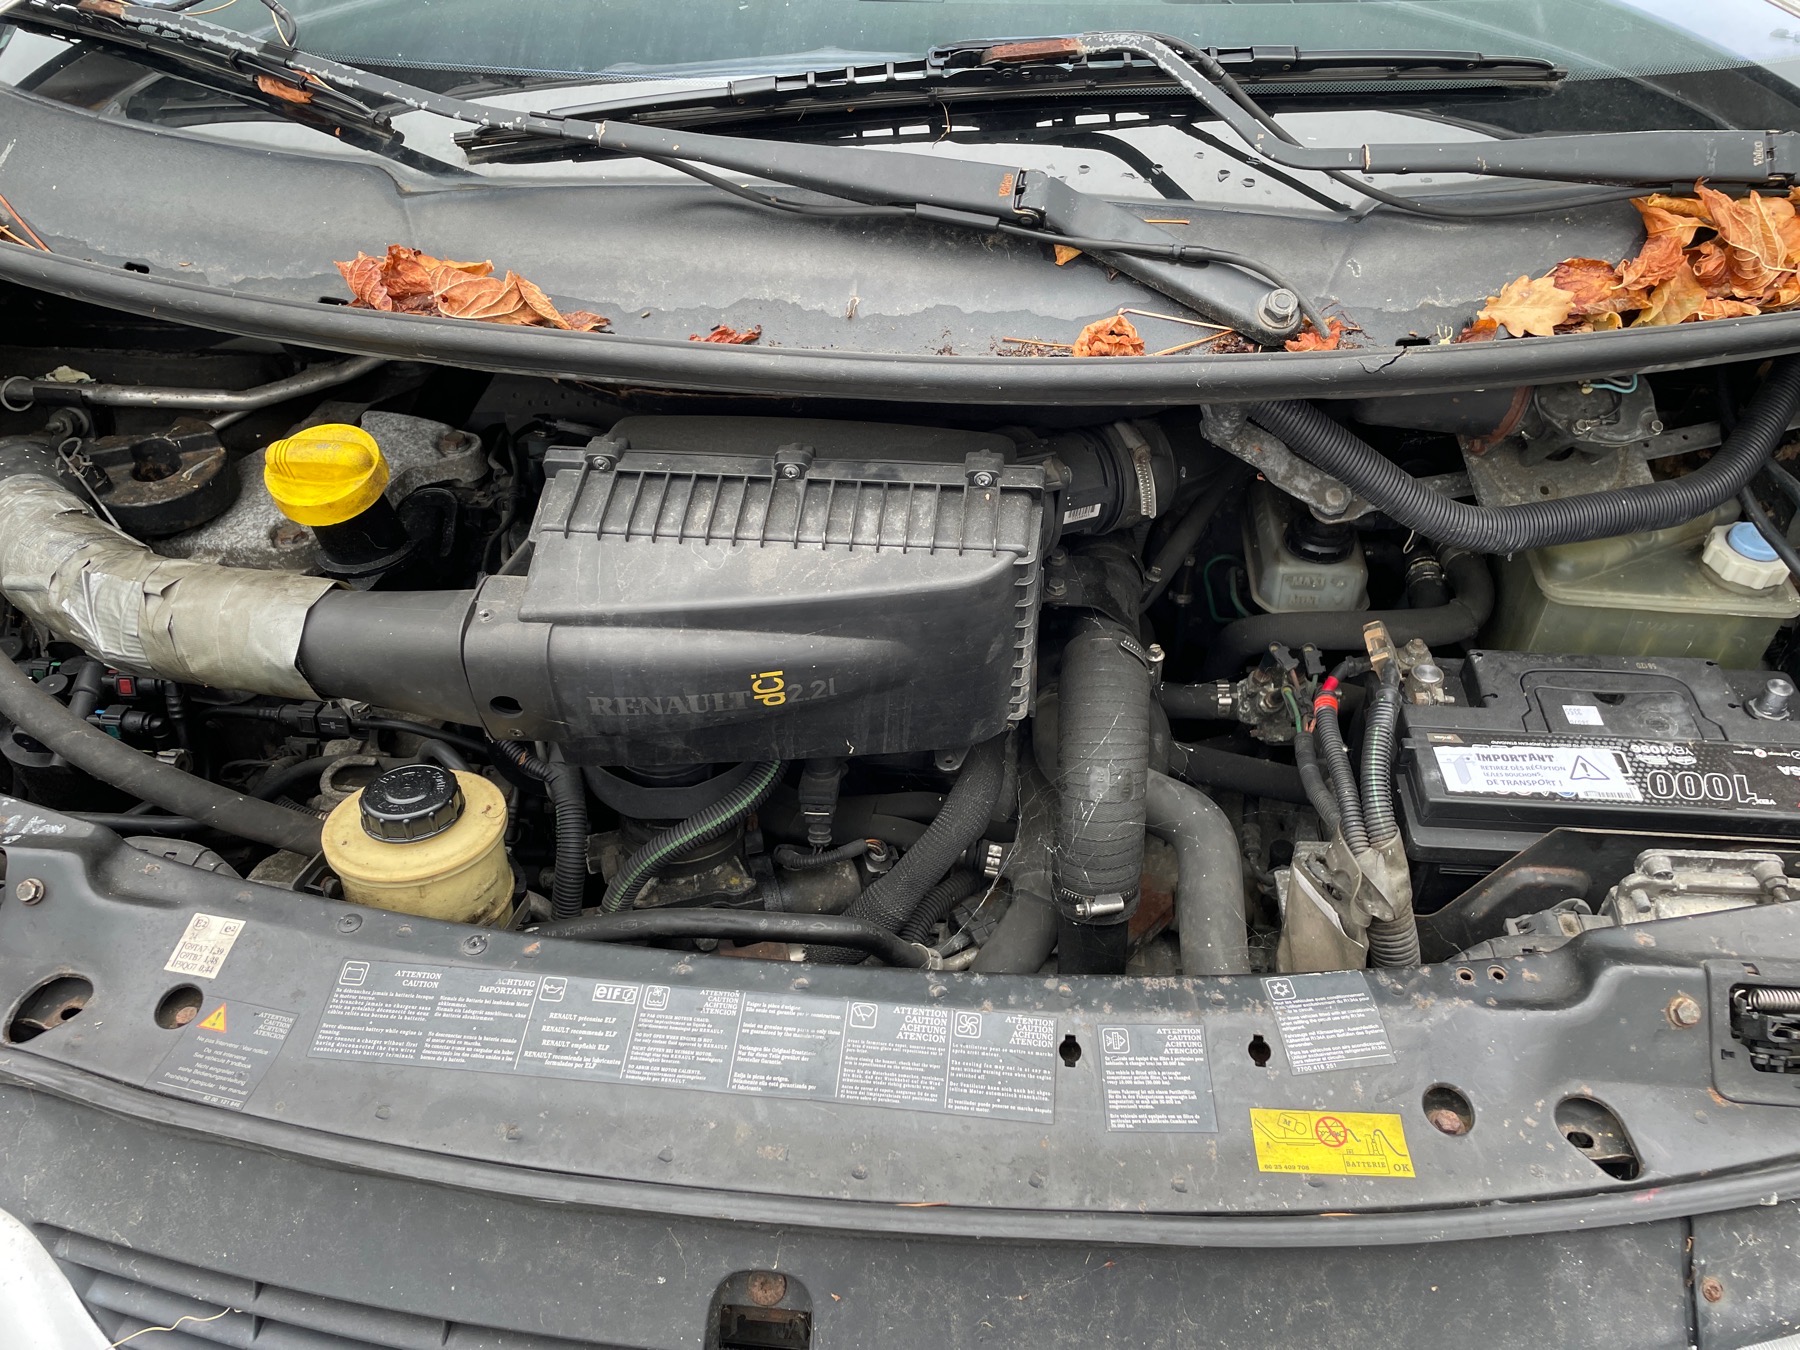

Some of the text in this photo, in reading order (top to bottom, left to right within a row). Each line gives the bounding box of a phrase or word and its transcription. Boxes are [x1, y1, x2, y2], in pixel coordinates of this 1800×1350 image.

[586, 690, 750, 717] RENAULT
[751, 670, 786, 706] dCi
[1475, 752, 1555, 763] IMPORTANT
[1480, 764, 1508, 772] RETIREZ
[1503, 779, 1556, 787] TRANSPORT
[1647, 770, 1757, 804] 1000
[394, 970, 443, 980] ATTENTION
[402, 979, 440, 989] CAUTION
[496, 978, 536, 987] ACHTUNG
[478, 986, 534, 996] IMPORTANTE
[595, 986, 621, 1000] elf
[701, 1008, 737, 1016] ATENCION
[894, 1007, 948, 1017] ATTENTION
[549, 1012, 577, 1021] RENAULT
[604, 1017, 617, 1025] ELF
[905, 1016, 947, 1026] CAUTION
[1006, 1016, 1054, 1027] ATTENTION
[542, 1025, 570, 1033] RENAULT
[900, 1024, 947, 1034] ACHTUNG
[1016, 1024, 1054, 1034] CAUTION
[897, 1032, 946, 1043] ATENCION
[1013, 1031, 1053, 1041] ACHTUNG
[542, 1039, 570, 1048] RENAULT
[1010, 1038, 1053, 1048] ATENCION
[524, 1051, 552, 1059] RENAULT
[1393, 1164, 1411, 1172] OK
